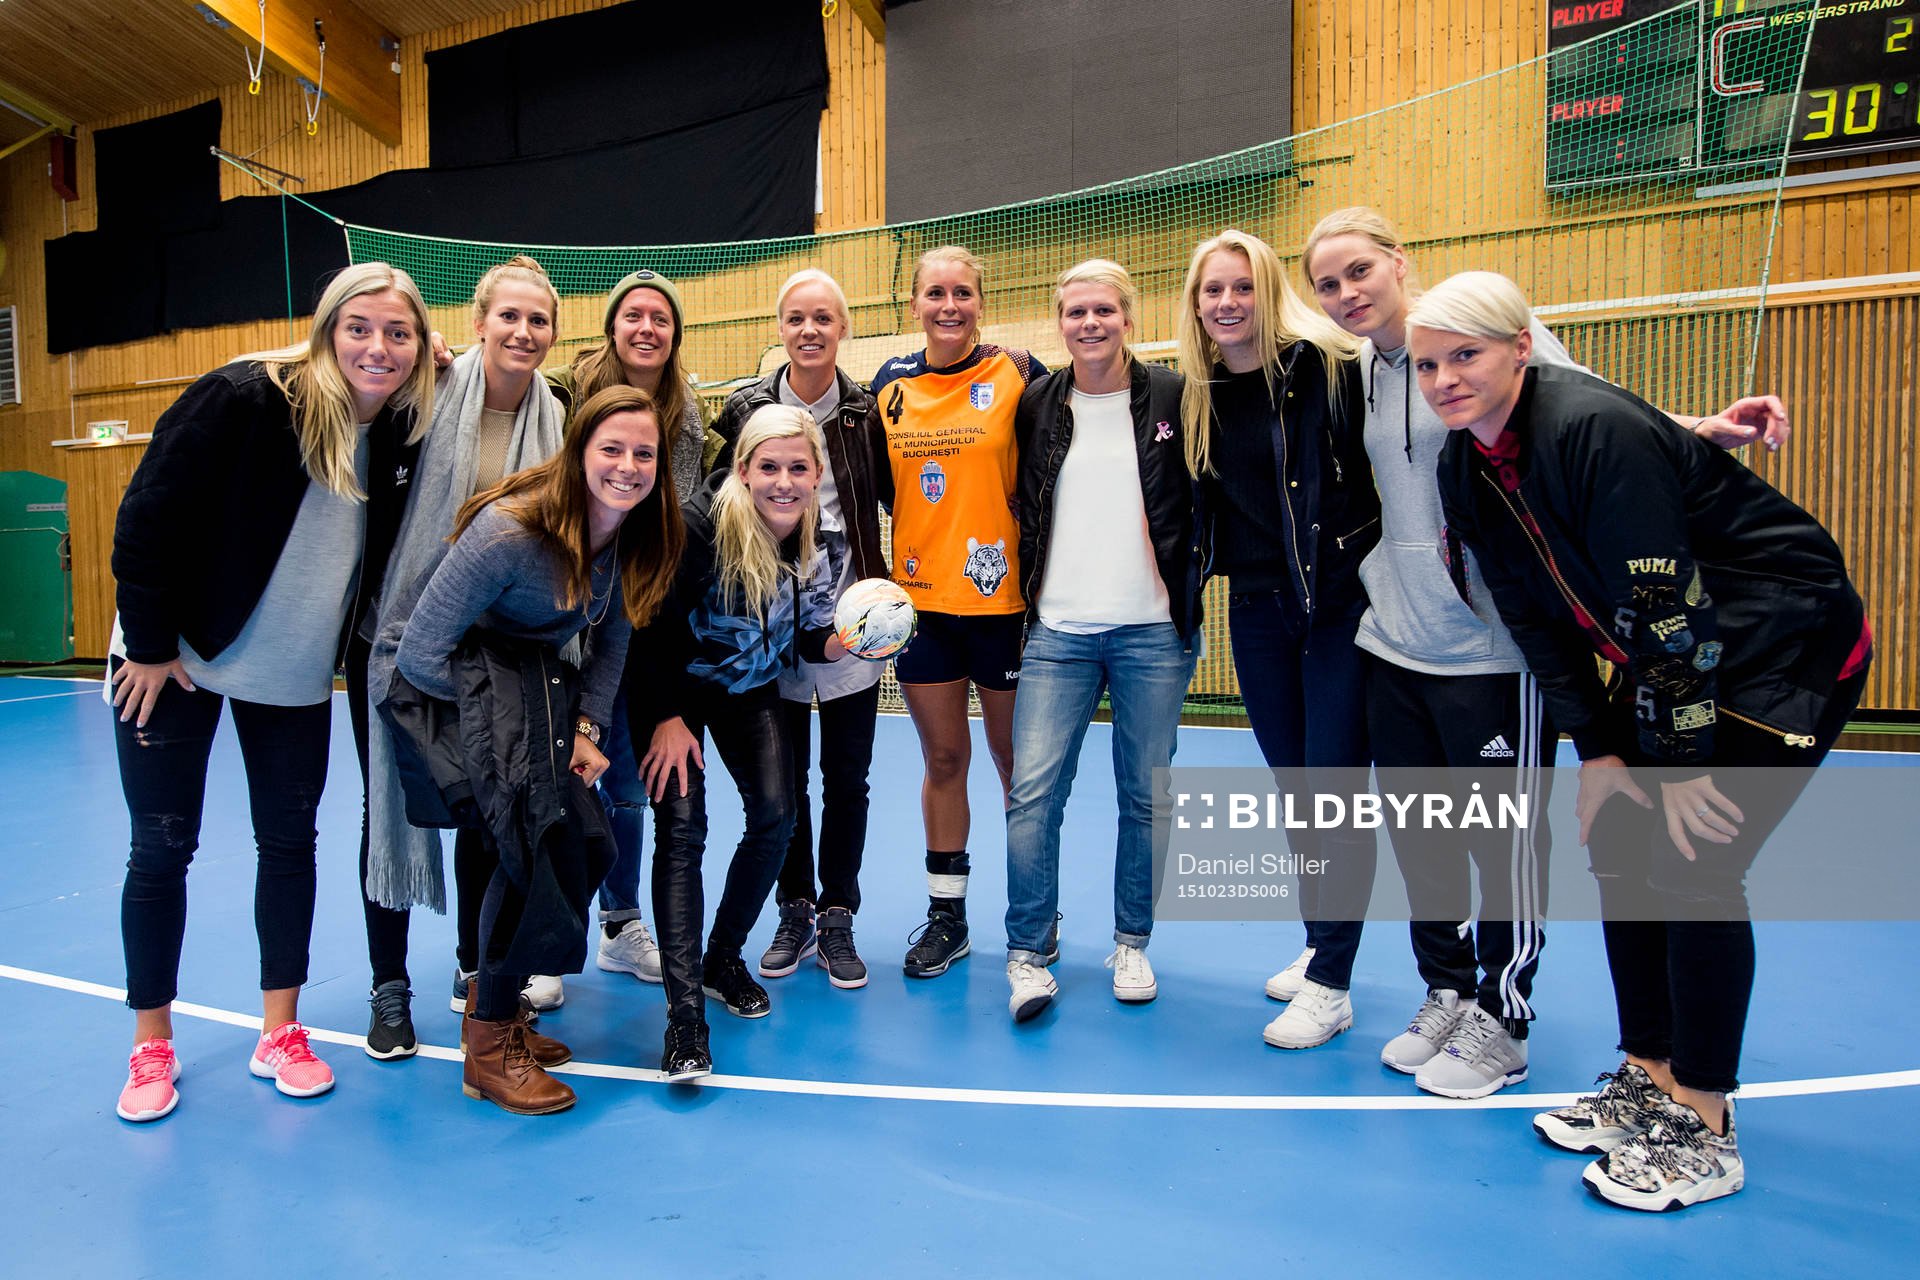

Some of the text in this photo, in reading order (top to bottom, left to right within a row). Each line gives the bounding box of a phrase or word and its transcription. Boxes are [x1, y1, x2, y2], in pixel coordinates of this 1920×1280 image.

[1552, 0, 1623, 27] PLAYER
[1770, 0, 1905, 27] WESTERSTRAND
[1885, 17, 1913, 53] 2
[1552, 94, 1623, 121] PLAYER
[887, 384, 903, 425] 4
[888, 427, 986, 440] CONSILIUL GENERAL
[904, 437, 975, 448] MUNICIPIULUI
[1626, 557, 1677, 576] PUMA
[1480, 749, 1514, 757] adidas
